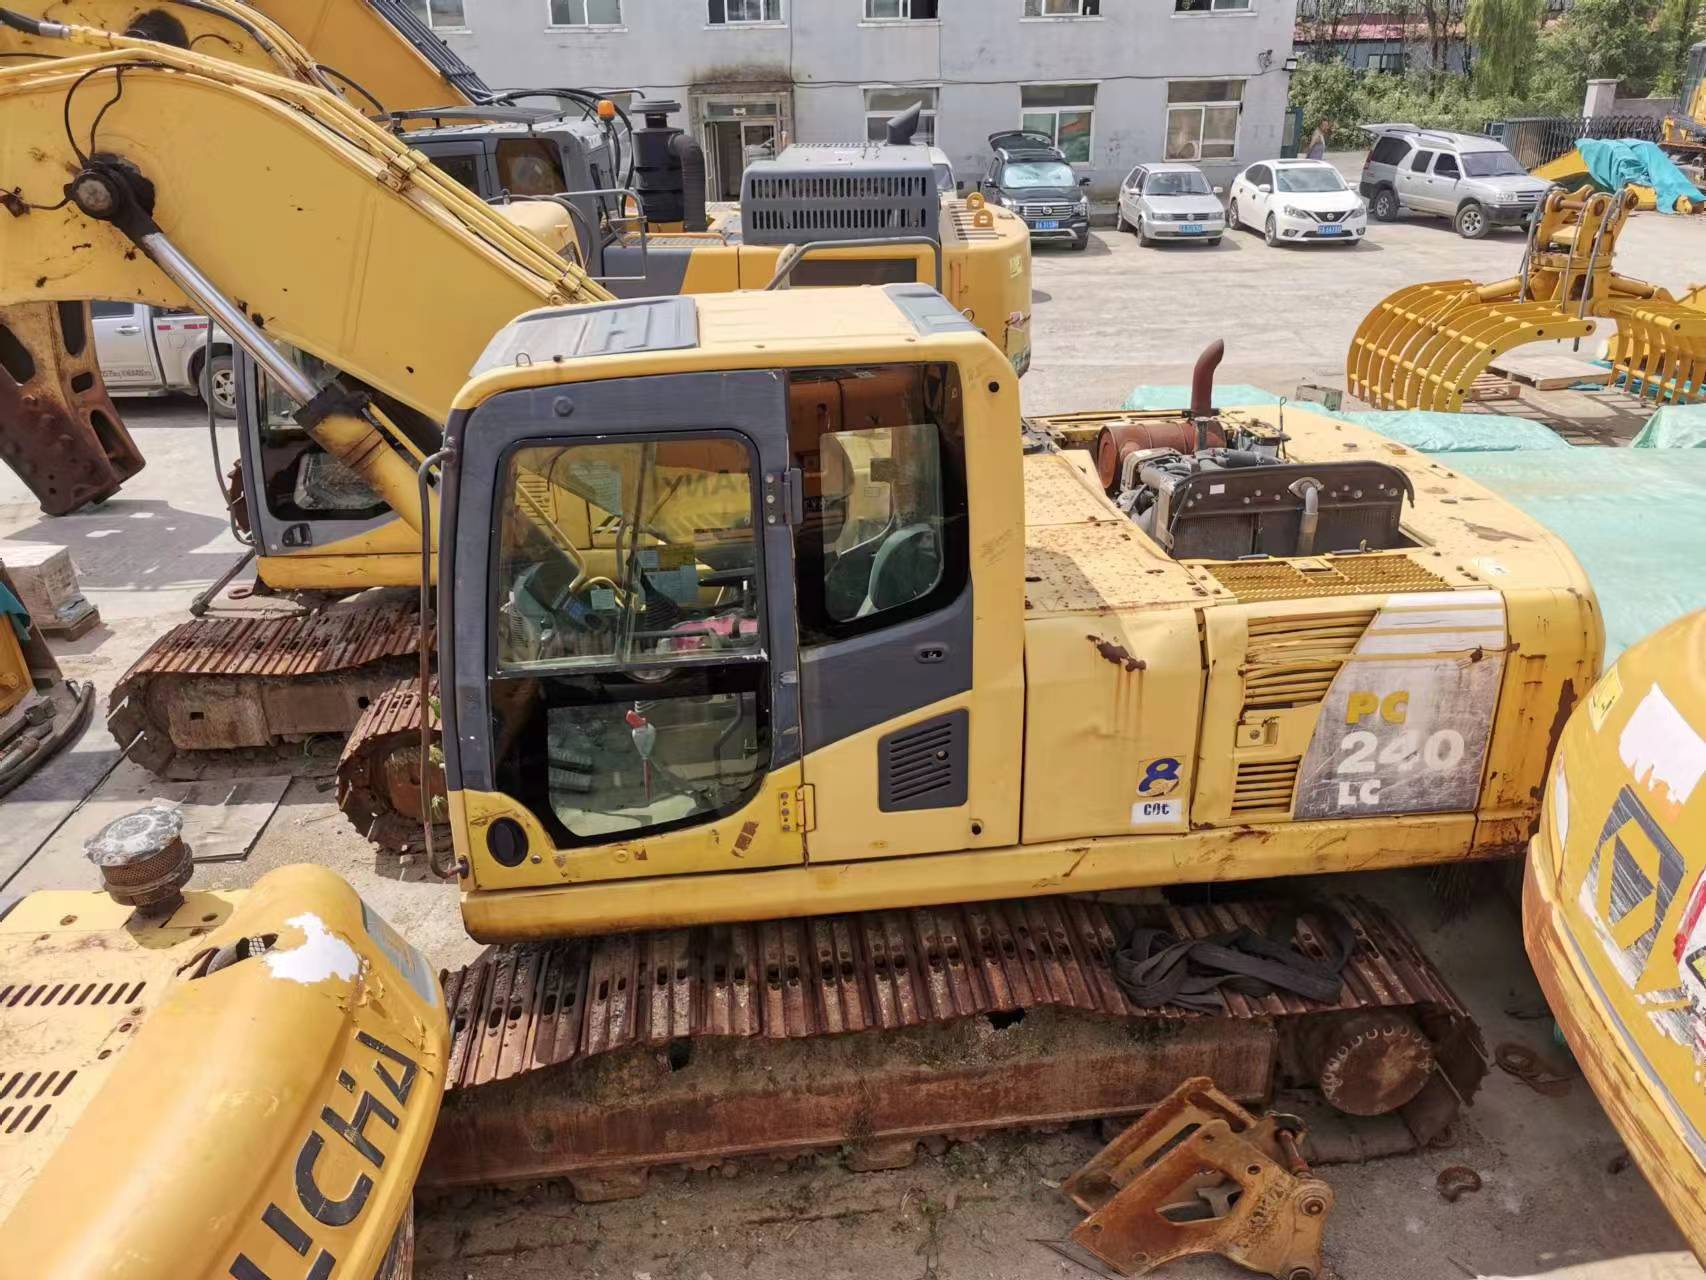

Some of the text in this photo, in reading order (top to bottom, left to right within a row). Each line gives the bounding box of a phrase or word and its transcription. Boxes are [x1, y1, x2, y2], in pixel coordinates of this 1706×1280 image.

[1346, 690, 1410, 725] PC
[1337, 729, 1465, 774] 240
[1337, 779, 1382, 806] LC
